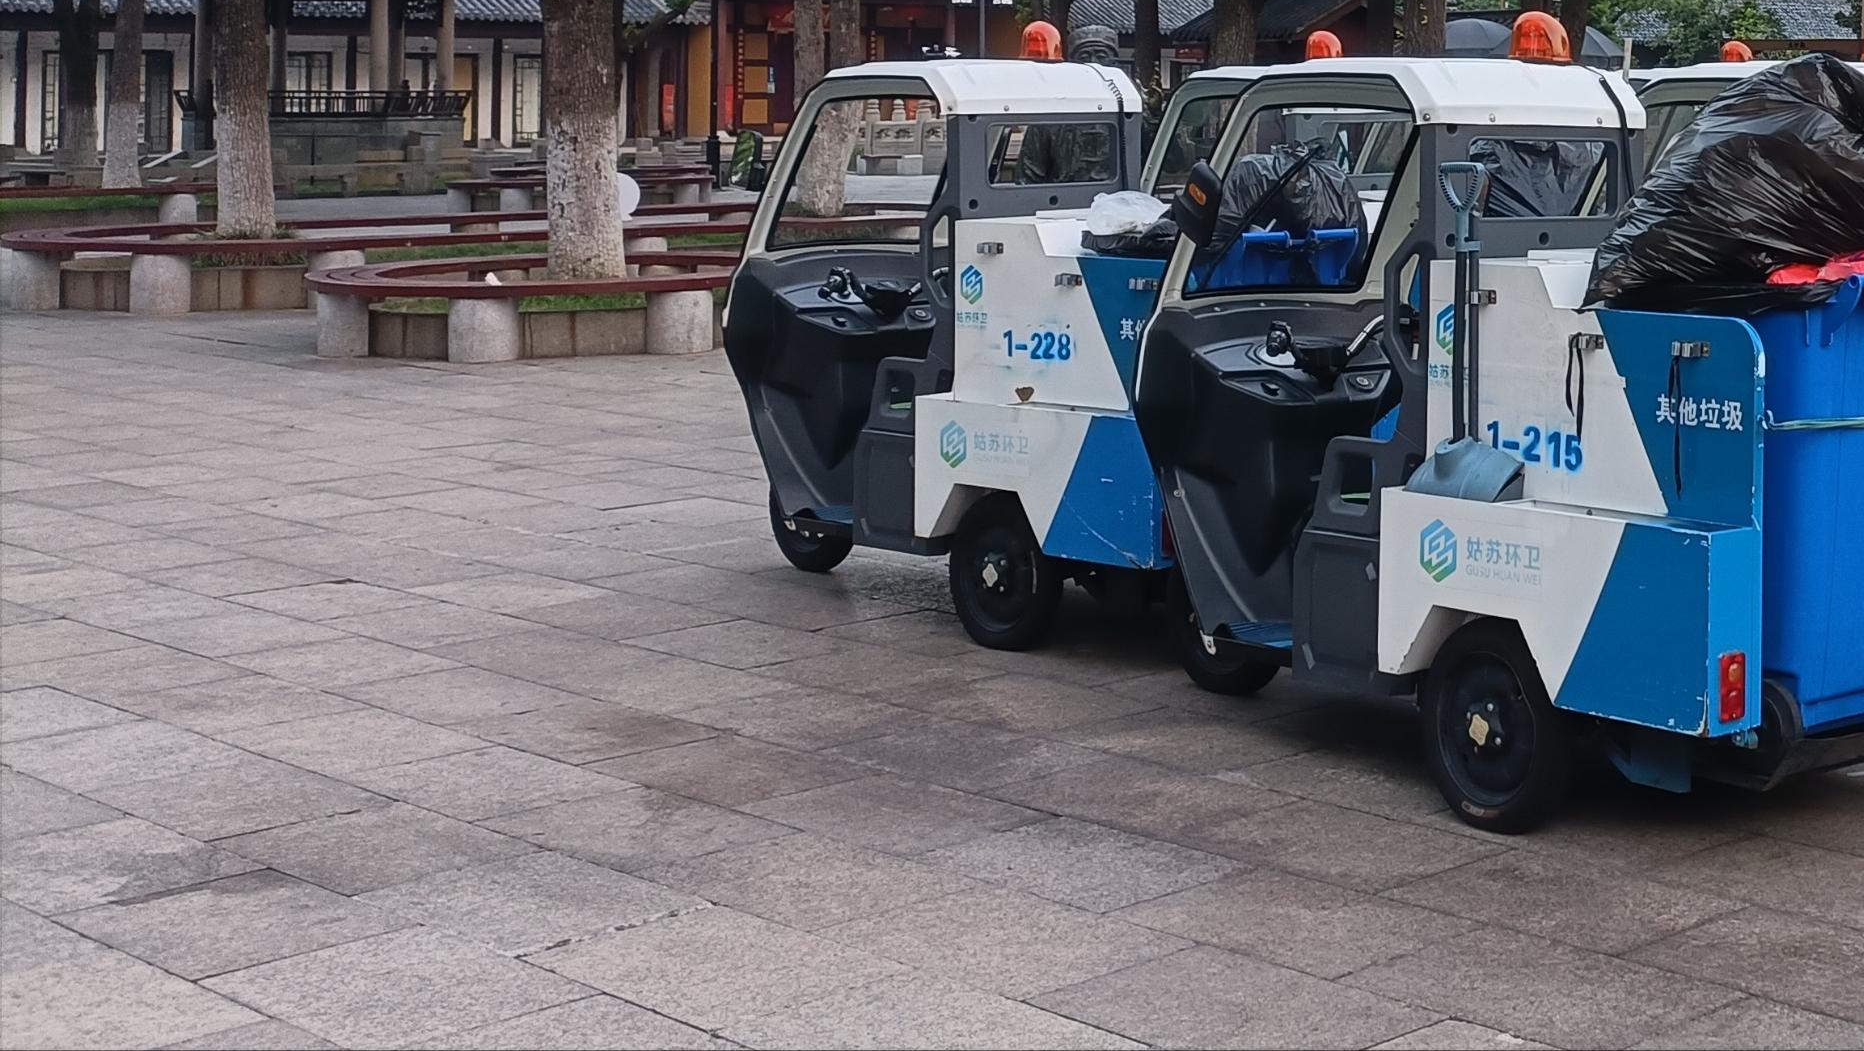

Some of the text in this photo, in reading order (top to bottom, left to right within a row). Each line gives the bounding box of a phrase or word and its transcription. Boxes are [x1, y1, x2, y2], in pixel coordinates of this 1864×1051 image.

[1003, 330, 1071, 361] 1-228
[1656, 393, 1744, 432] 其他垃圾
[973, 431, 1029, 455] 姑苏环卫
[1487, 420, 1584, 472] 1-215
[1466, 536, 1541, 571] 姑苏环卫
